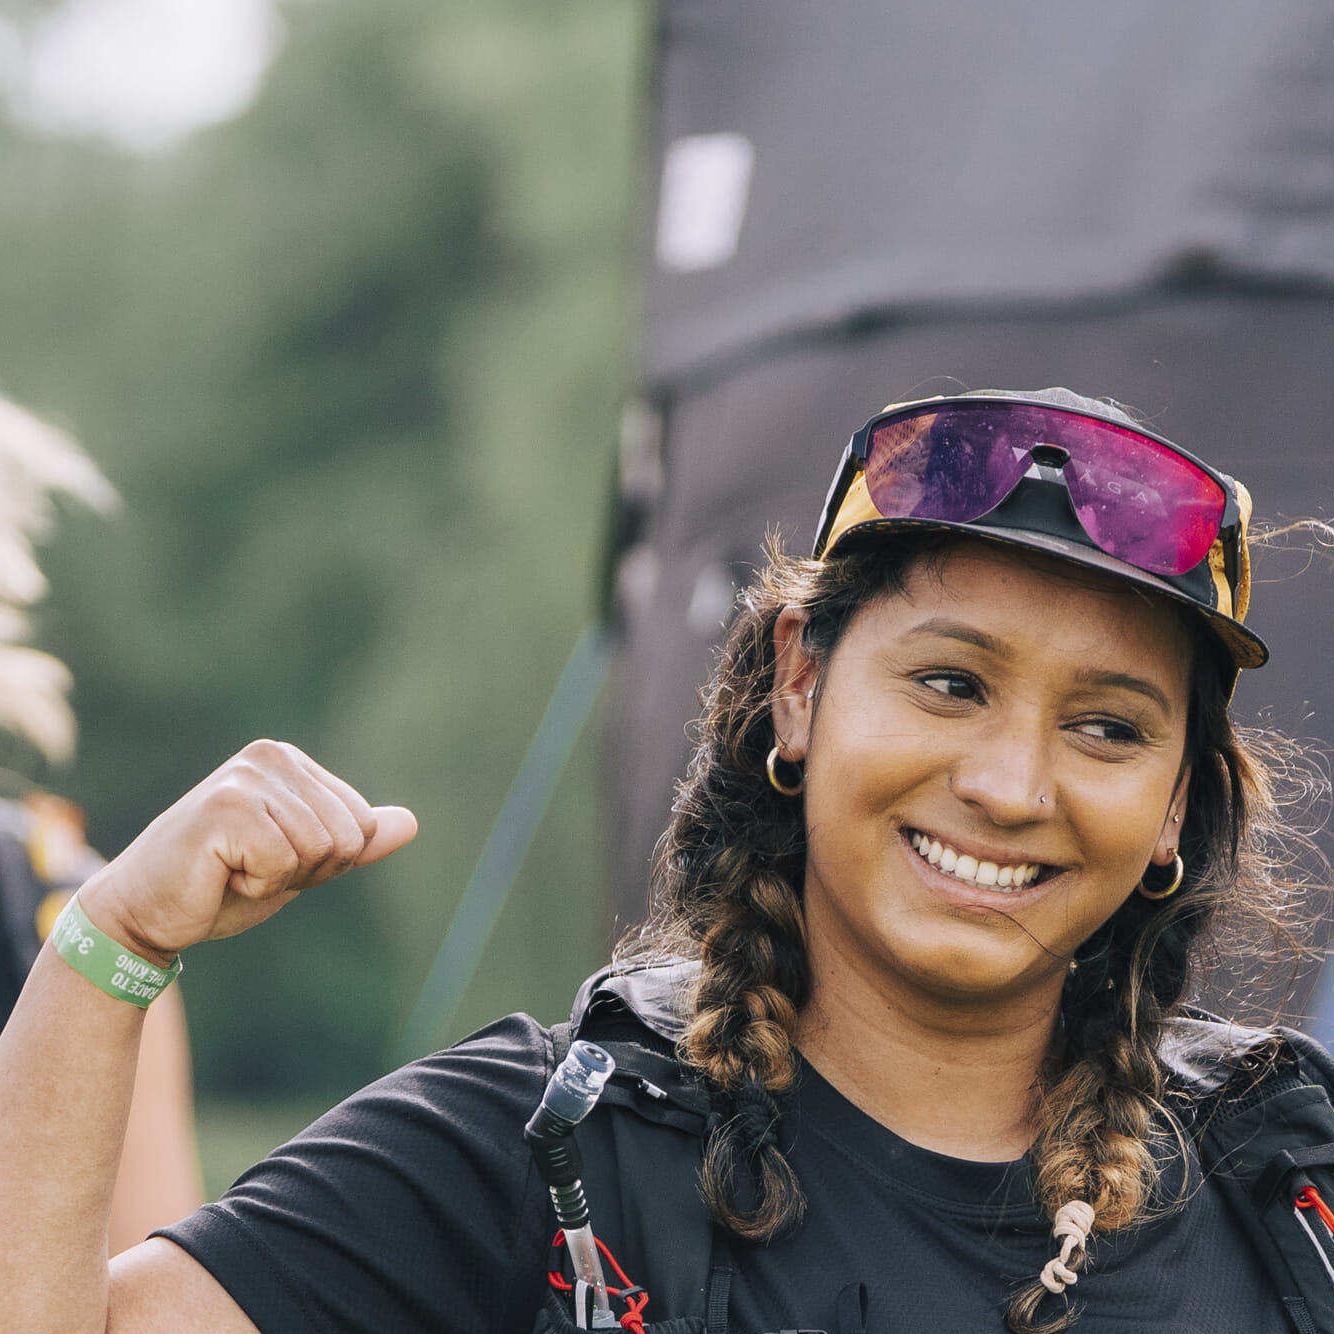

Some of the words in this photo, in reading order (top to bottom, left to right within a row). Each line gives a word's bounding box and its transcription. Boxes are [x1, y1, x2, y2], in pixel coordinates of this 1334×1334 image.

[115, 954, 149, 980] KING
[111, 972, 131, 990] TO
[128, 980, 160, 1000] RACE
